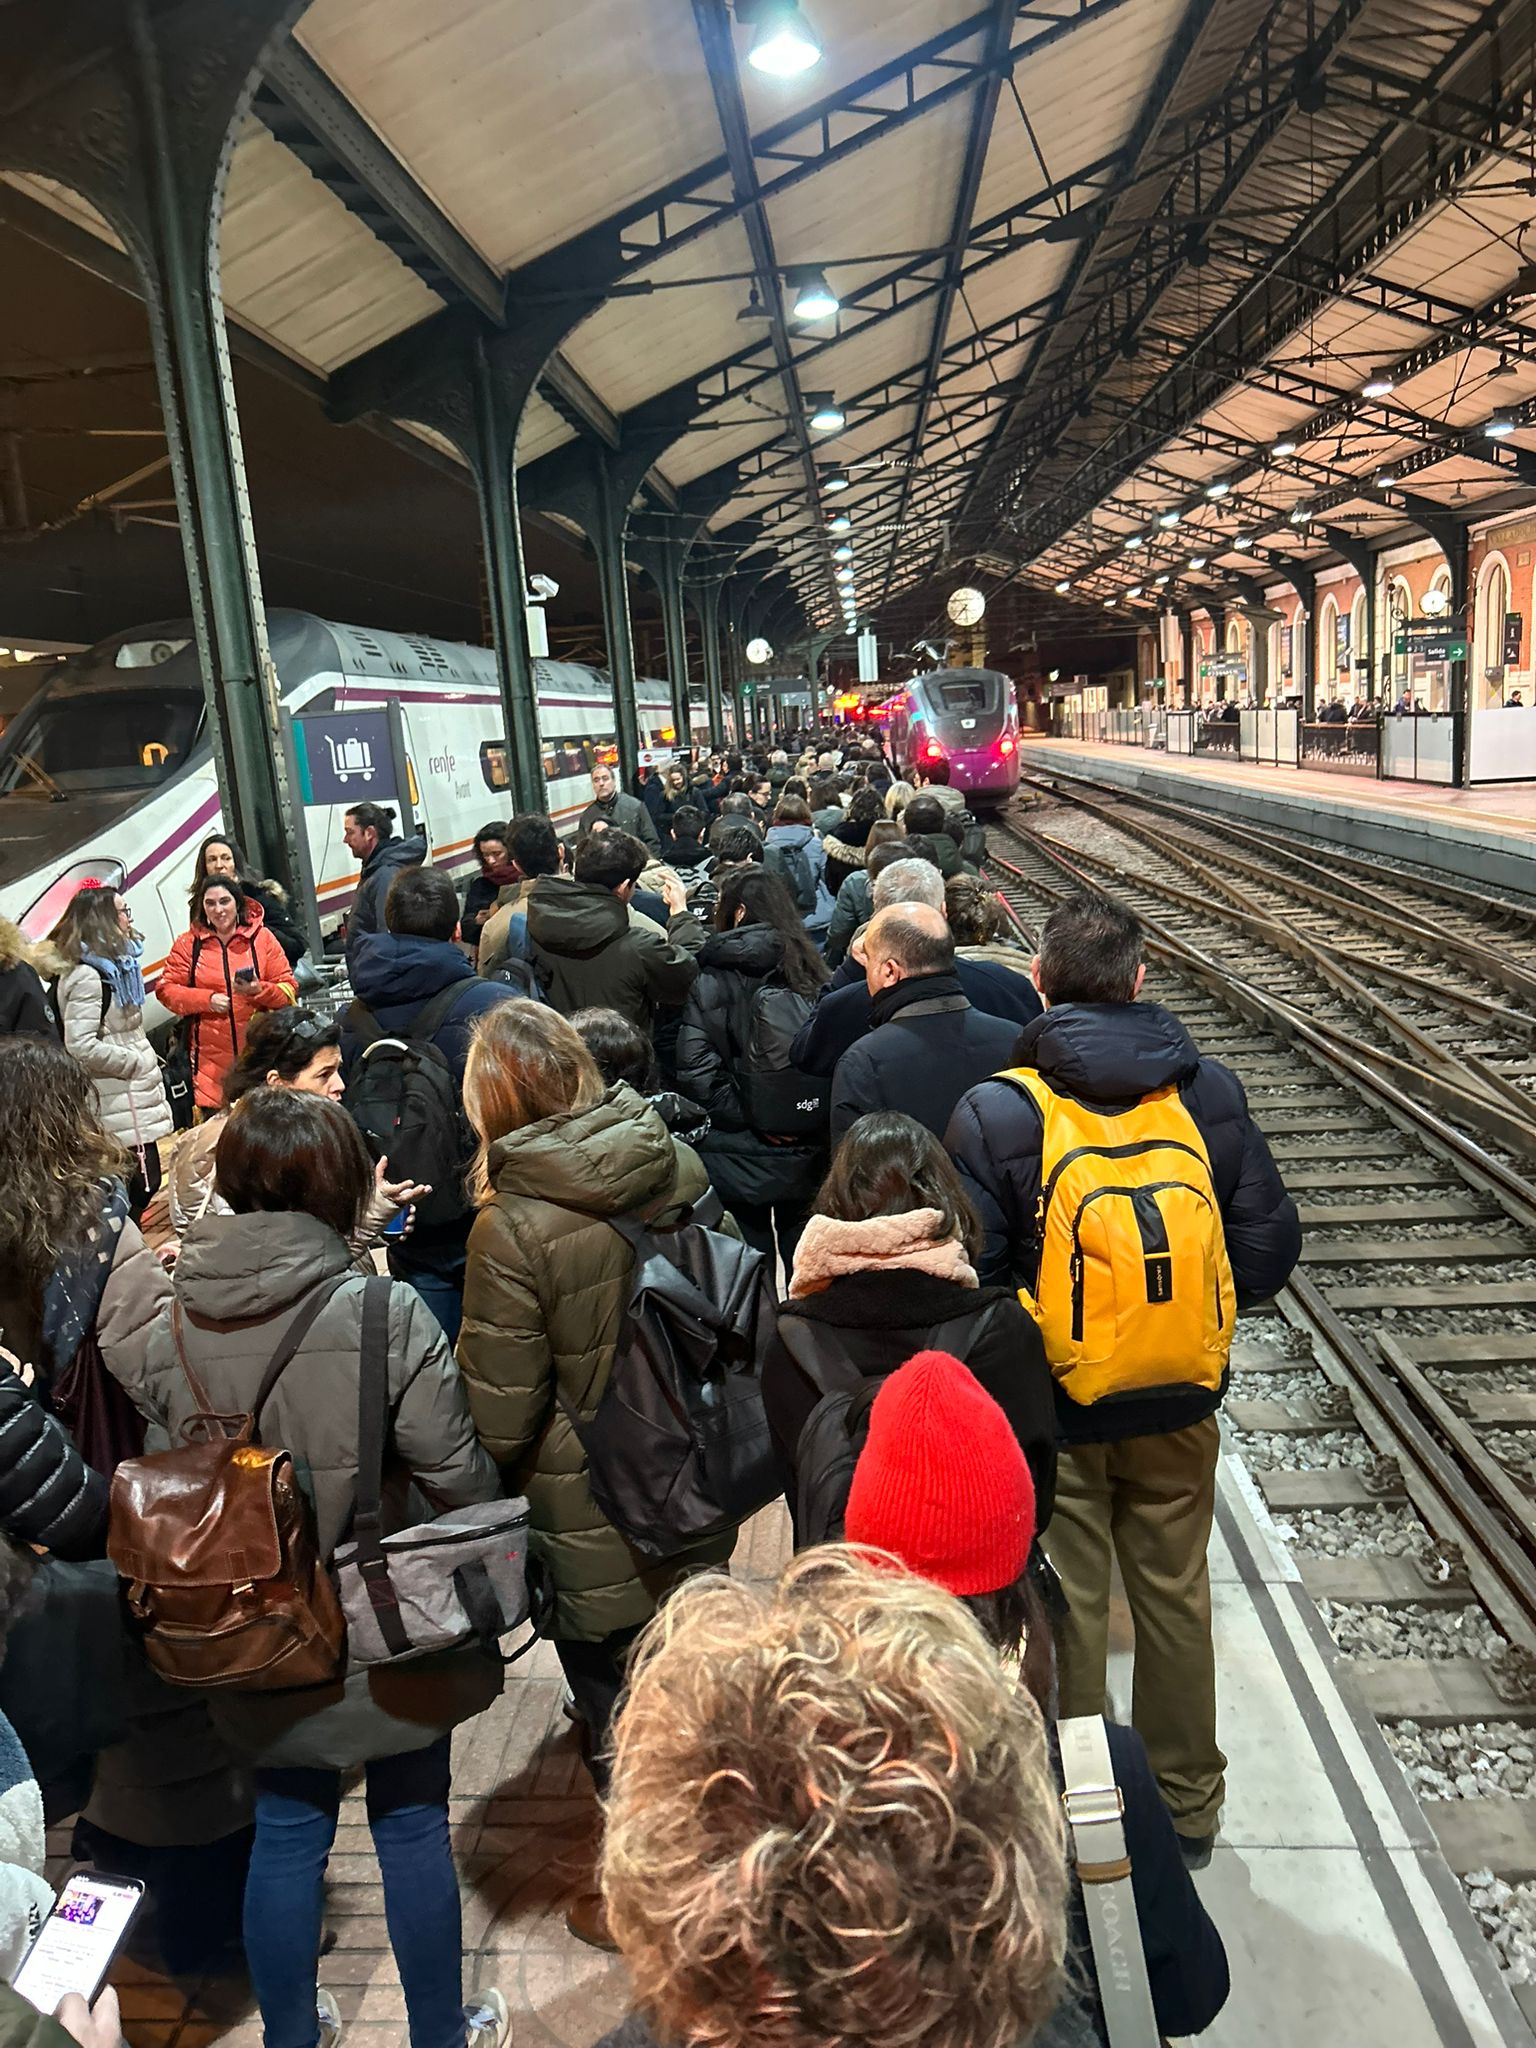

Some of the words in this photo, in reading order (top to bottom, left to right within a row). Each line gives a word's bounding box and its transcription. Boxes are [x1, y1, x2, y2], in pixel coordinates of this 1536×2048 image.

[1489, 525, 1536, 545] VALLADOLI
[1428, 647, 1446, 655] Salida
[429, 745, 456, 783] renfe
[796, 1098, 813, 1111] sdg
[1098, 1883, 1132, 1992] COACH
